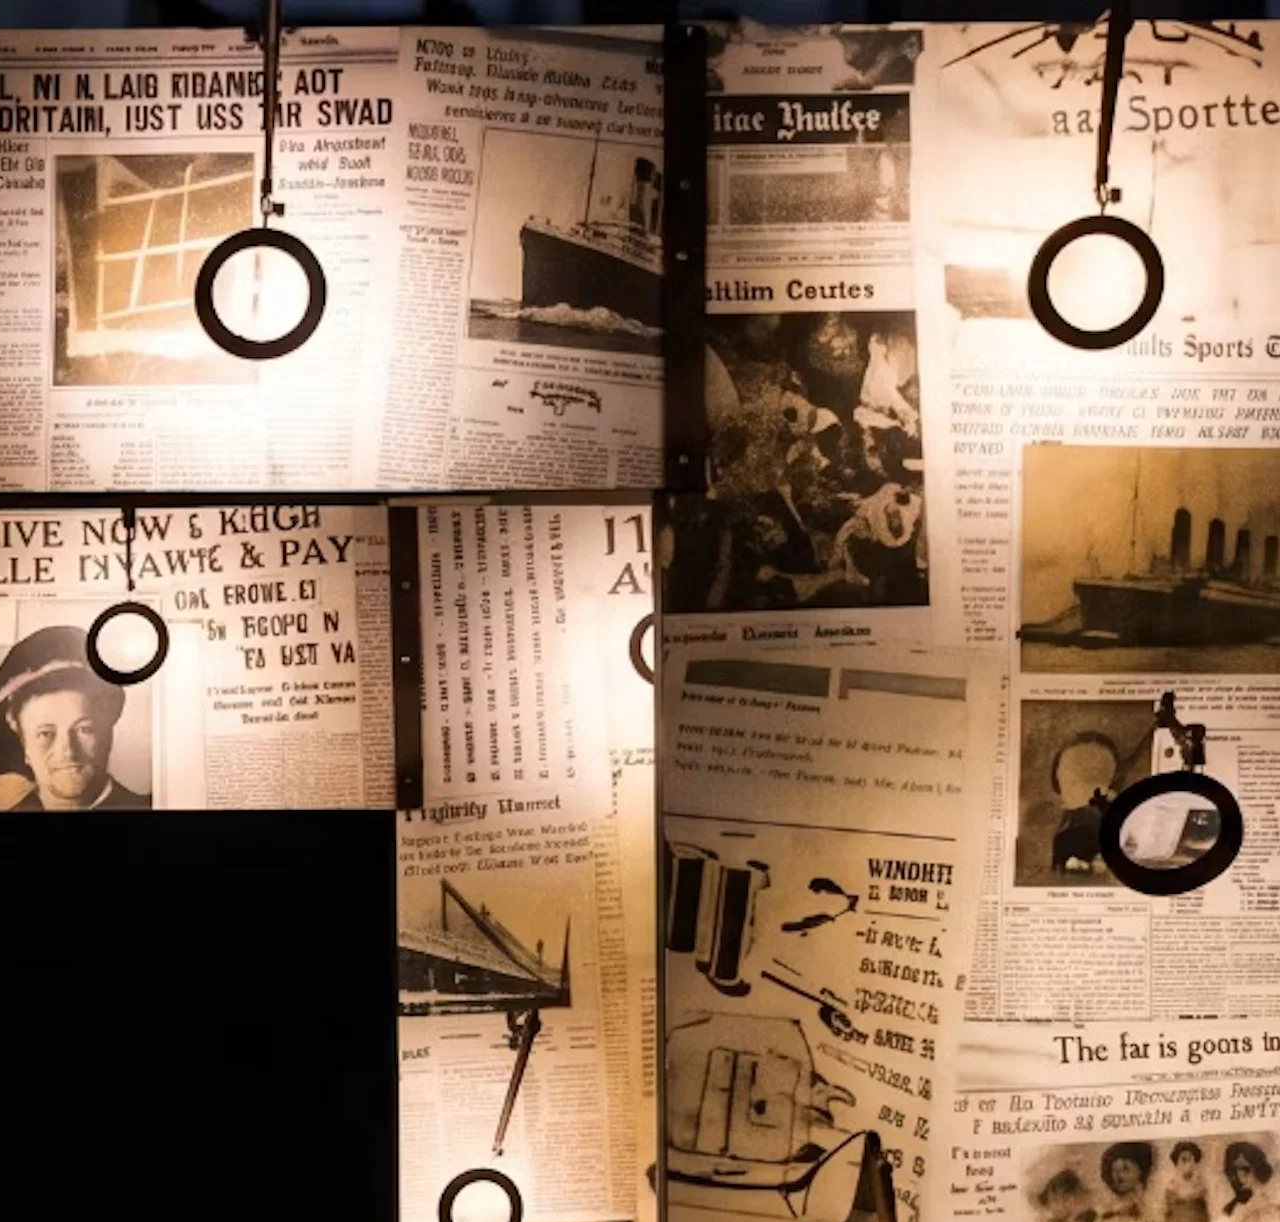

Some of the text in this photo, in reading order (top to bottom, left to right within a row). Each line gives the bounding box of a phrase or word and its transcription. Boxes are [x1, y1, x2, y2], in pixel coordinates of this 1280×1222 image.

[81, 514, 172, 546] NOW
[280, 535, 354, 566] PAY
[1053, 1034, 1109, 1064] The
